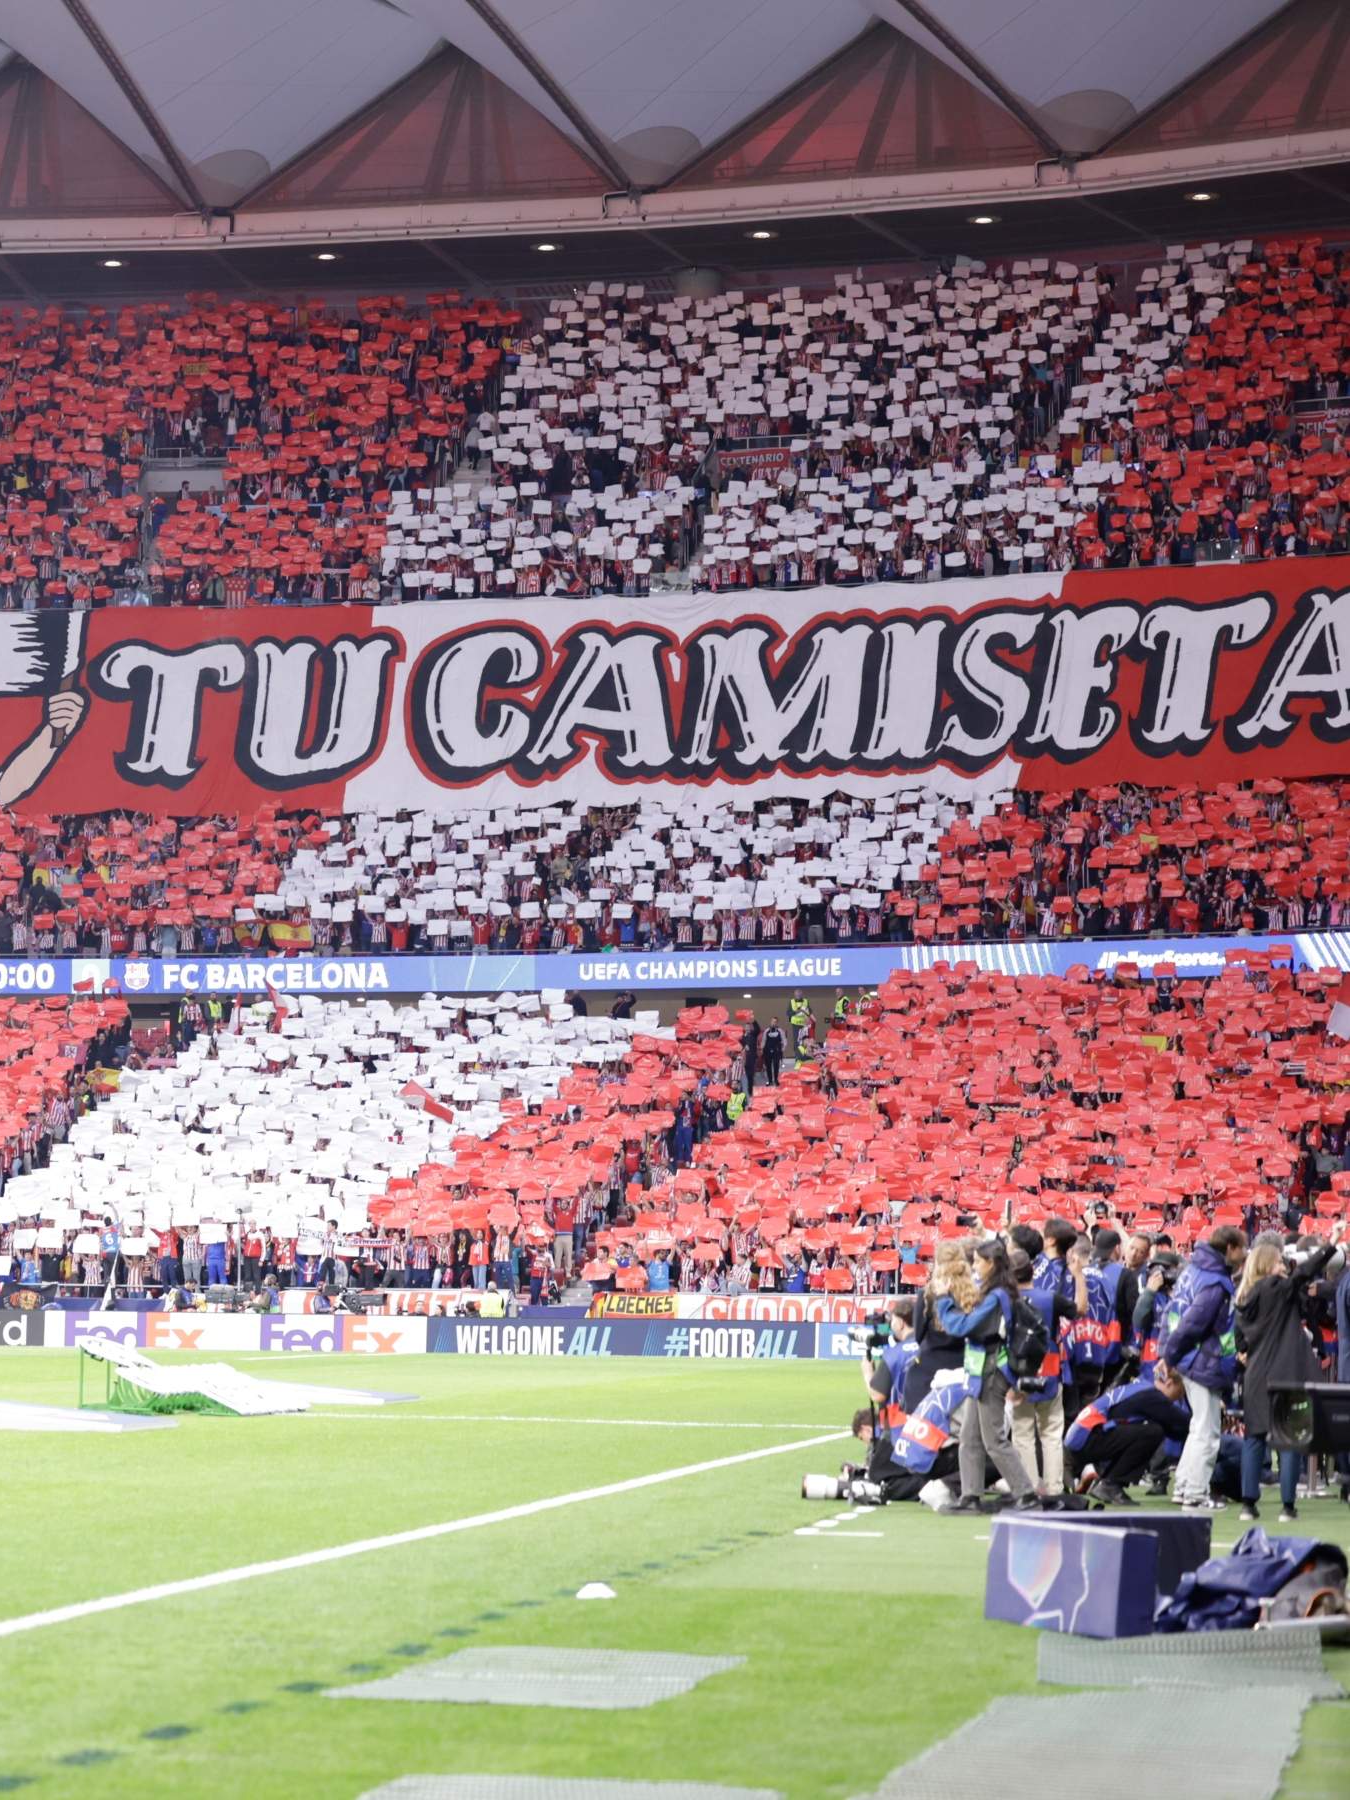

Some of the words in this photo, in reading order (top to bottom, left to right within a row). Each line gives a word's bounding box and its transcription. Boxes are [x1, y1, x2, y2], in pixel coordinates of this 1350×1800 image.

[720, 452, 784, 468] CENTENARIO
[94, 632, 402, 788] TU
[416, 590, 1350, 782] CAMISETA
[162, 963, 200, 990] FC
[206, 962, 389, 990] BARCELONA
[579, 962, 630, 981] UEFA
[635, 959, 758, 980] CHAMPIONS
[762, 957, 842, 978] LEAGUE
[606, 1294, 674, 1314] LOECHES
[259, 1314, 402, 1354] FedEx
[455, 1325, 564, 1356] WELCOME
[565, 1325, 613, 1356] ALL
[663, 1327, 799, 1359] #FOOTBALL
